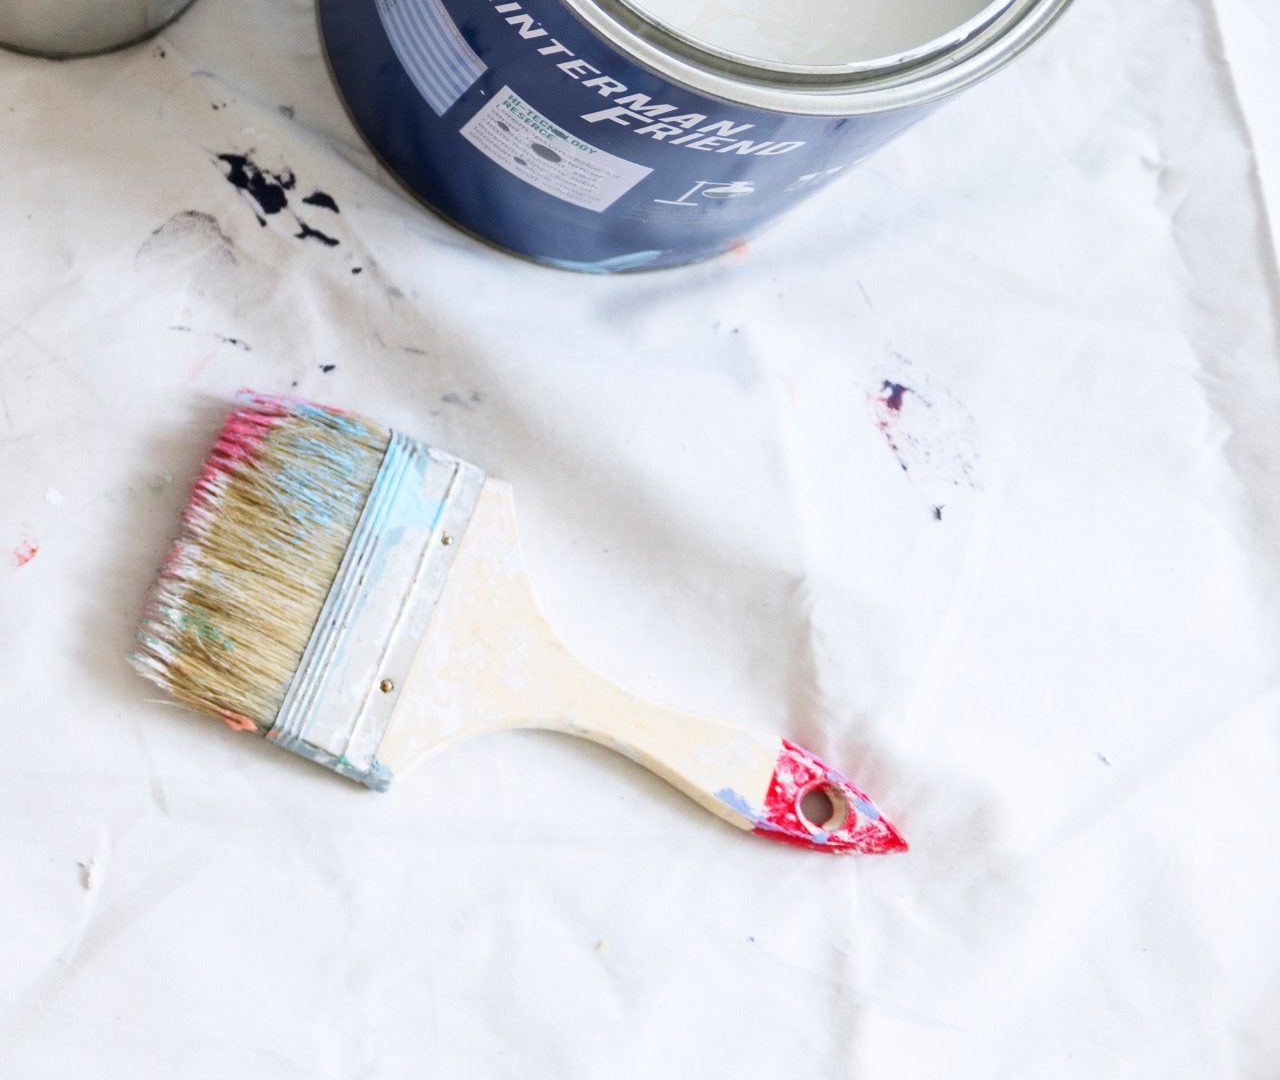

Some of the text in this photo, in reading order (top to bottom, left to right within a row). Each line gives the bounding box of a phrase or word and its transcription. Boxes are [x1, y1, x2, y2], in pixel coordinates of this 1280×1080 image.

[502, 101, 555, 141] RESERCE
[507, 94, 599, 155] HI-TECNLOGY
[580, 106, 807, 157] FRIEND
